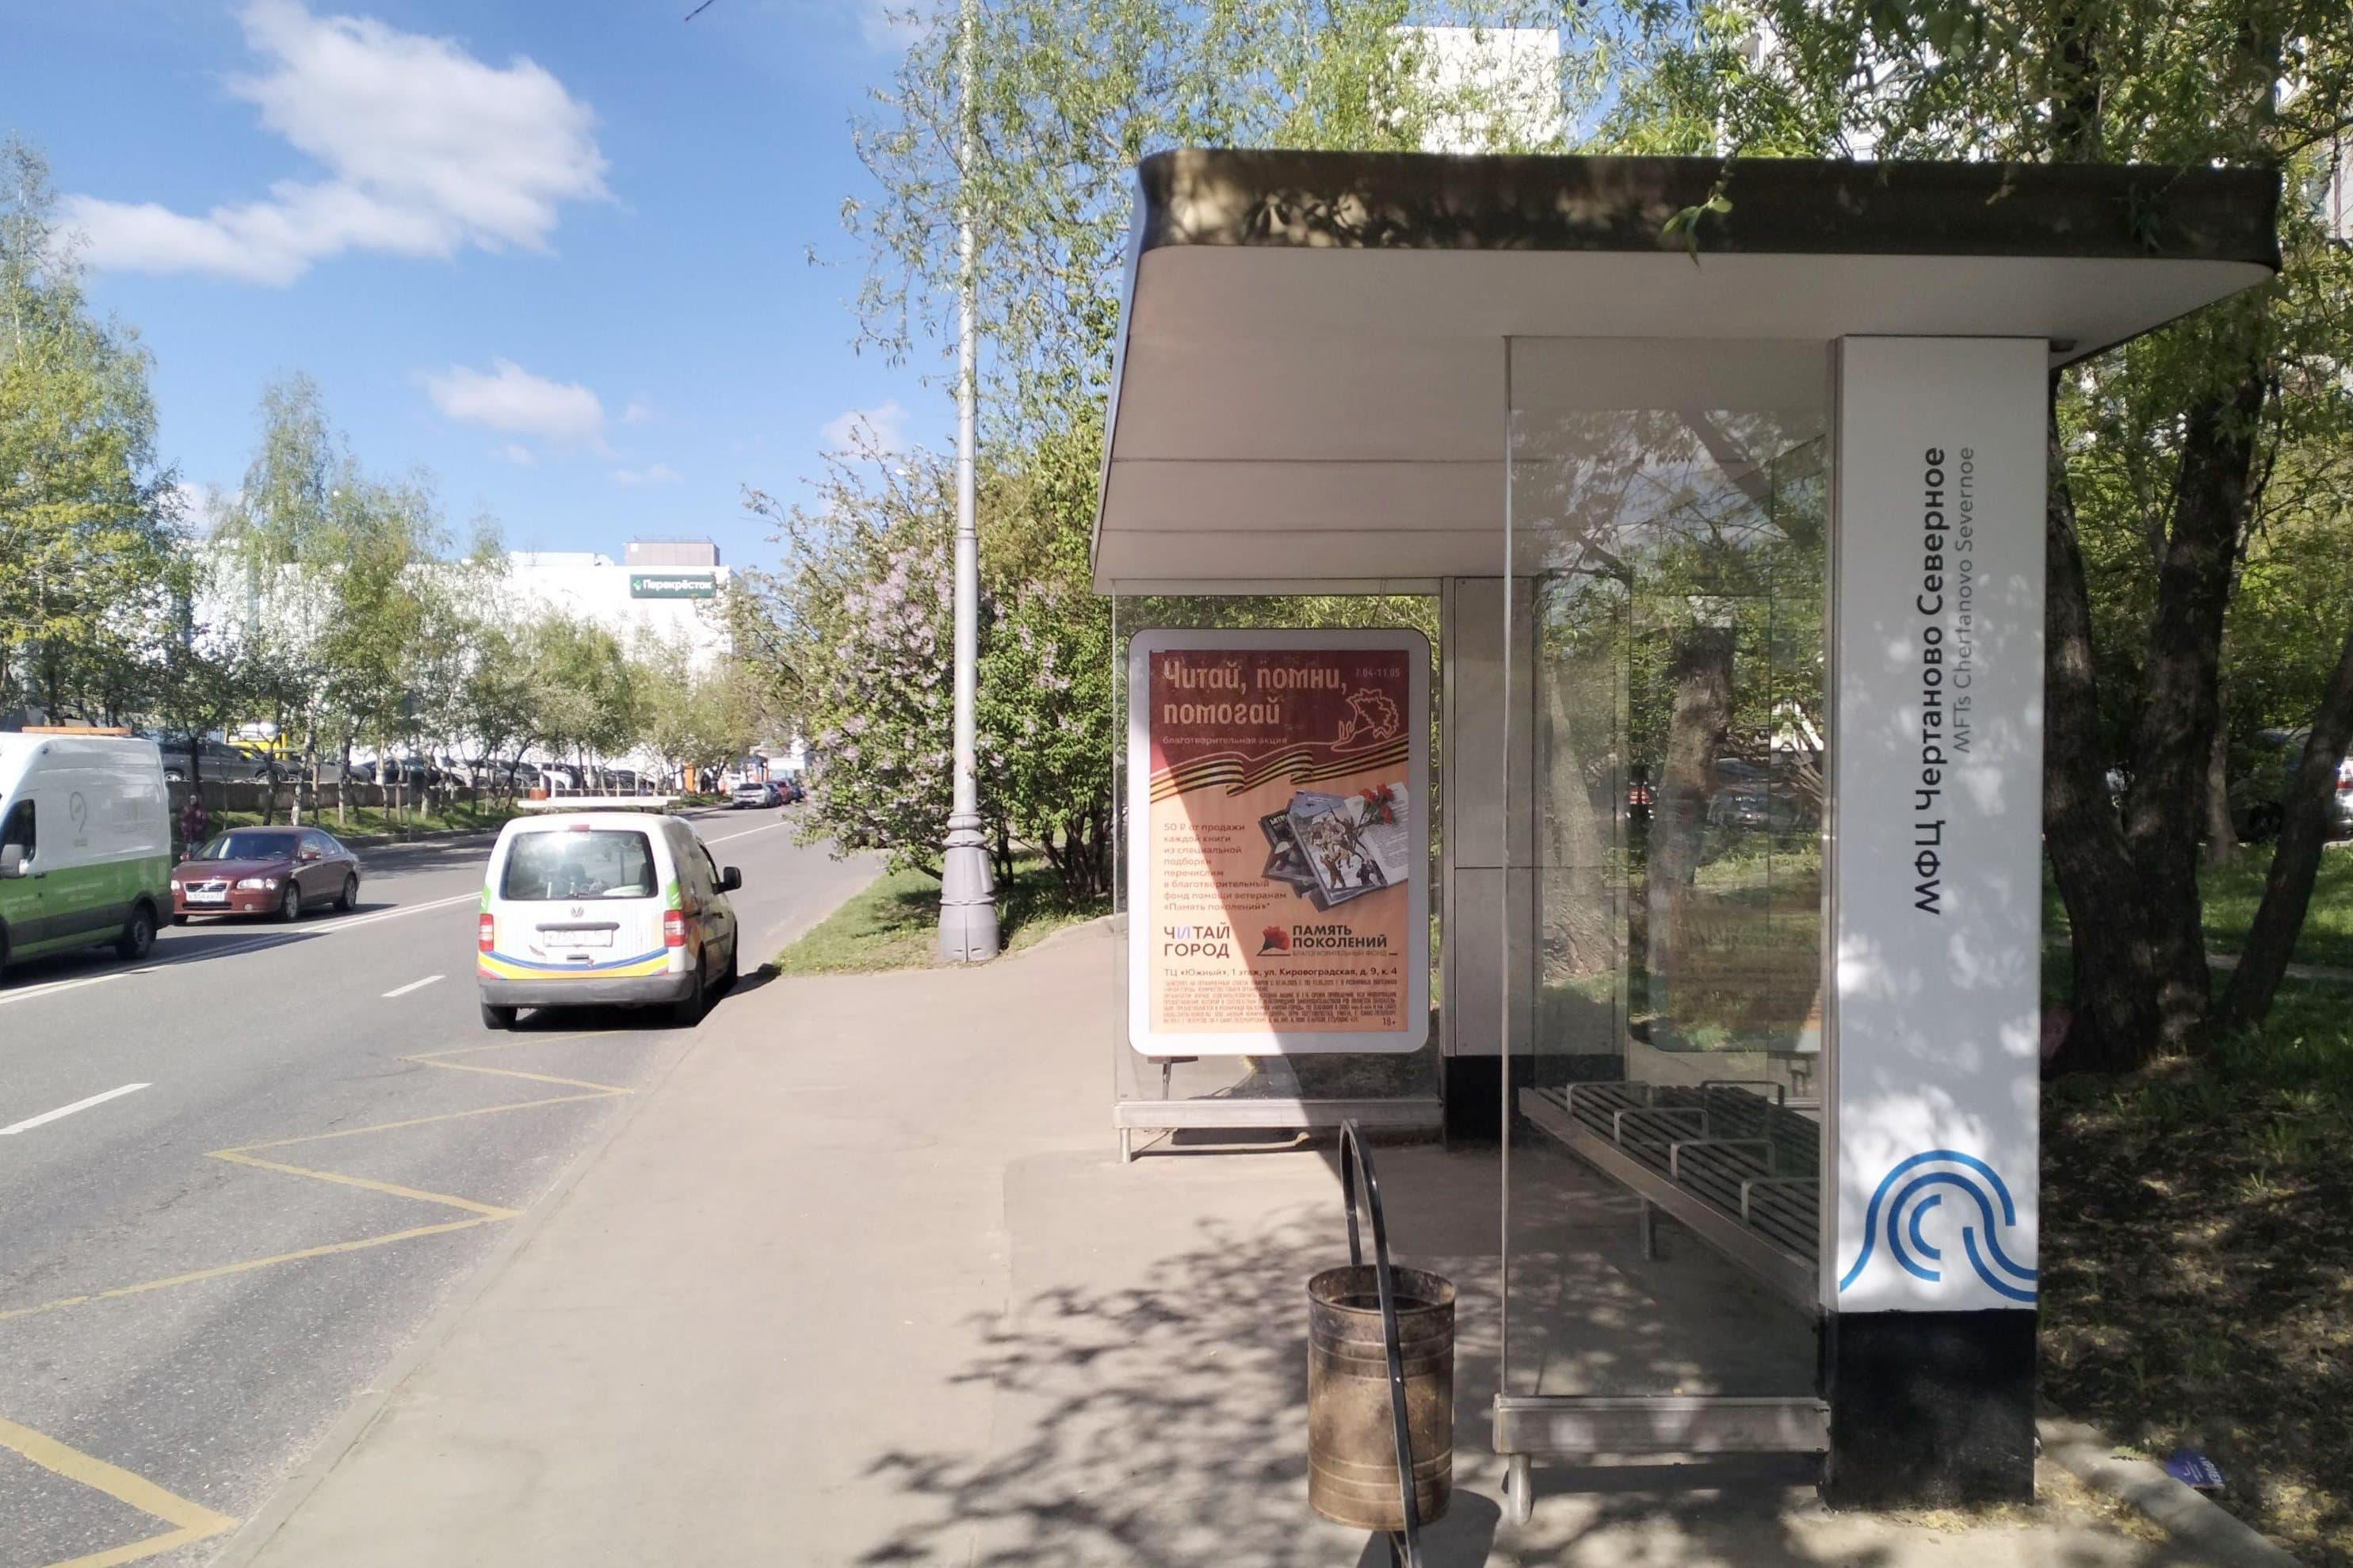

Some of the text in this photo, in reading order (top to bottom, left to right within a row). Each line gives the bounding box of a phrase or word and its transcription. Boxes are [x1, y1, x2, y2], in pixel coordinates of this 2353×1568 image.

[1953, 447, 1974, 753] MFTs Chertanovo Severnoe
[1163, 660, 1346, 696] Читай, помни,
[1914, 447, 1950, 915] МФЦ Чертаново Северное
[1163, 697, 1280, 725] помогай
[1162, 736, 1256, 746] благотворительная
[1164, 822, 1178, 831] 50
[1201, 824, 1245, 834] продажи
[1164, 835, 1199, 844] каждой
[1177, 845, 1242, 856] специальной
[1164, 858, 1212, 868] подборки
[1164, 870, 1224, 879] перечислим
[1171, 879, 1269, 890] благотворительный
[1164, 891, 1190, 901] фонд
[1234, 892, 1287, 901] ветеранам
[1163, 921, 1230, 940] ЧИТАЙ
[1292, 925, 1352, 936] ПАМЯТЬ
[1292, 933, 1387, 948] ПОКОЛЕНИЙ
[1164, 943, 1229, 959] ГОРОД
[1164, 968, 1178, 978] ТЦ
[1238, 969, 1262, 978] этаж,
[1263, 970, 1277, 979] ул.
[1279, 968, 1358, 978] Кировоградская,
[1359, 968, 1368, 977] д.
[1370, 967, 1379, 977] 9,
[1391, 967, 1397, 975] 4
[1382, 1017, 1396, 1027] 18+
